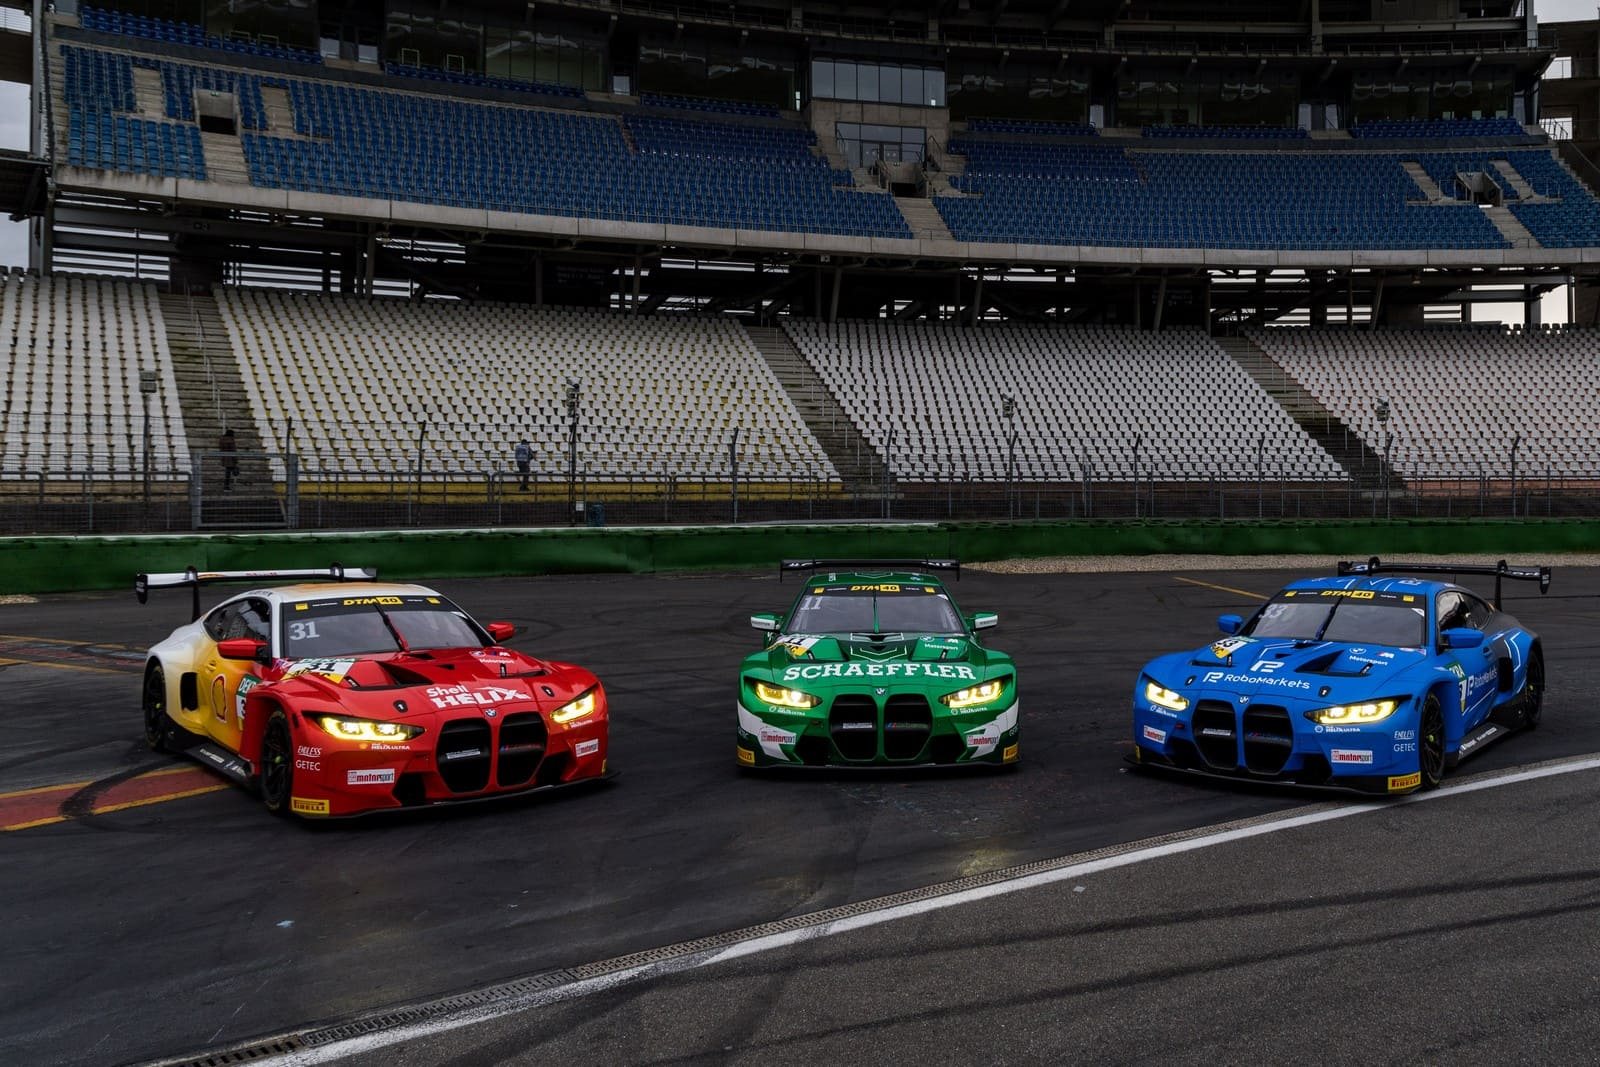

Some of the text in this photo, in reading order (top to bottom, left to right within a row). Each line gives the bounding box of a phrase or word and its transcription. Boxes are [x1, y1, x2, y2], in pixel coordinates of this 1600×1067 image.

[343, 598, 378, 606] DTM
[801, 596, 823, 610] 11
[288, 621, 320, 641] 31
[783, 663, 977, 681] SCHAEFFLER
[1224, 674, 1311, 690] RoboMarkets
[426, 684, 470, 697] Shell
[430, 686, 532, 708] HELIX
[1393, 743, 1416, 752] GETEC
[295, 759, 321, 771] GETEC
